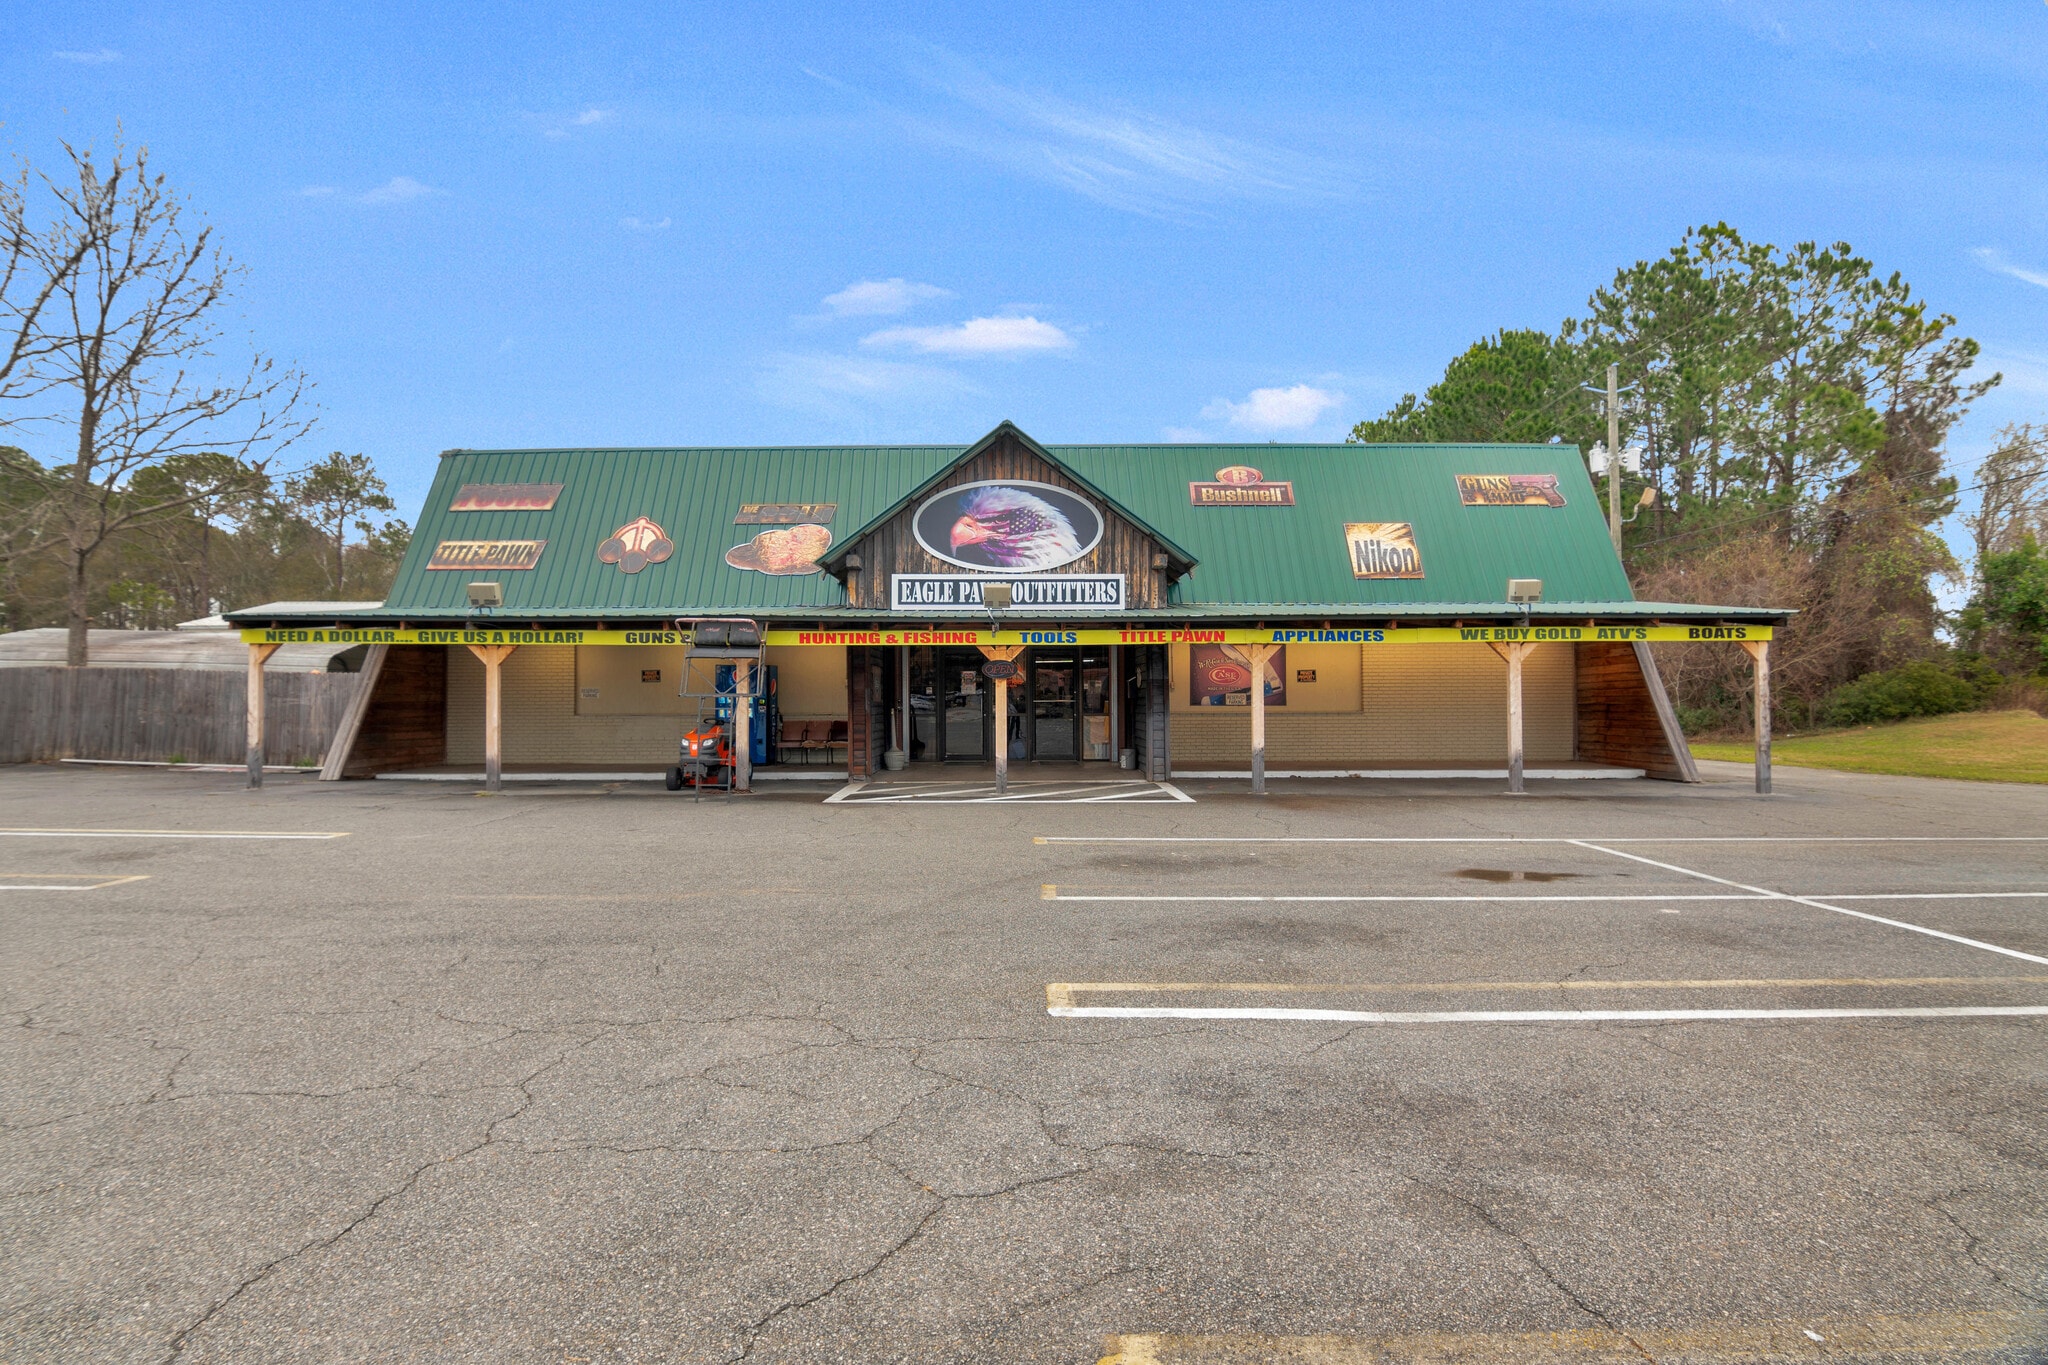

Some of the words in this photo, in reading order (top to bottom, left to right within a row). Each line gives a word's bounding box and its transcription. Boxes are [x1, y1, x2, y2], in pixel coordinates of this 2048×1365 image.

[1231, 469, 1249, 484] B
[1461, 477, 1510, 492] GUNS
[1201, 487, 1282, 502] Bushnell
[431, 544, 485, 565] TITLE
[483, 544, 538, 565] PAWN
[1354, 539, 1417, 573] Nikon
[901, 581, 953, 603] EAGLE
[959, 581, 1008, 603] PA
[1011, 581, 1117, 603] OUTFITTERS
[265, 630, 308, 642] NEED
[312, 630, 325, 642] A
[417, 631, 458, 643] GIVE
[463, 631, 488, 643] US
[491, 631, 505, 643] A
[508, 631, 584, 643] HOLLAR!
[625, 632, 676, 644] GUNS
[799, 632, 881, 644] HUNTING
[885, 634, 899, 644] &
[903, 632, 977, 644] FISHING
[1019, 631, 1078, 644] TOOLS
[1119, 631, 1167, 643] TITLE
[1171, 630, 1226, 643] PAWN
[1272, 630, 1385, 642] APPLIANCES
[1460, 628, 1489, 641] WE
[1494, 628, 1530, 640] BUY
[1535, 627, 1582, 640] GOLD
[1597, 628, 1647, 640] ATV'S
[1688, 627, 1747, 639] BOATS
[984, 664, 1015, 674] OPEN
